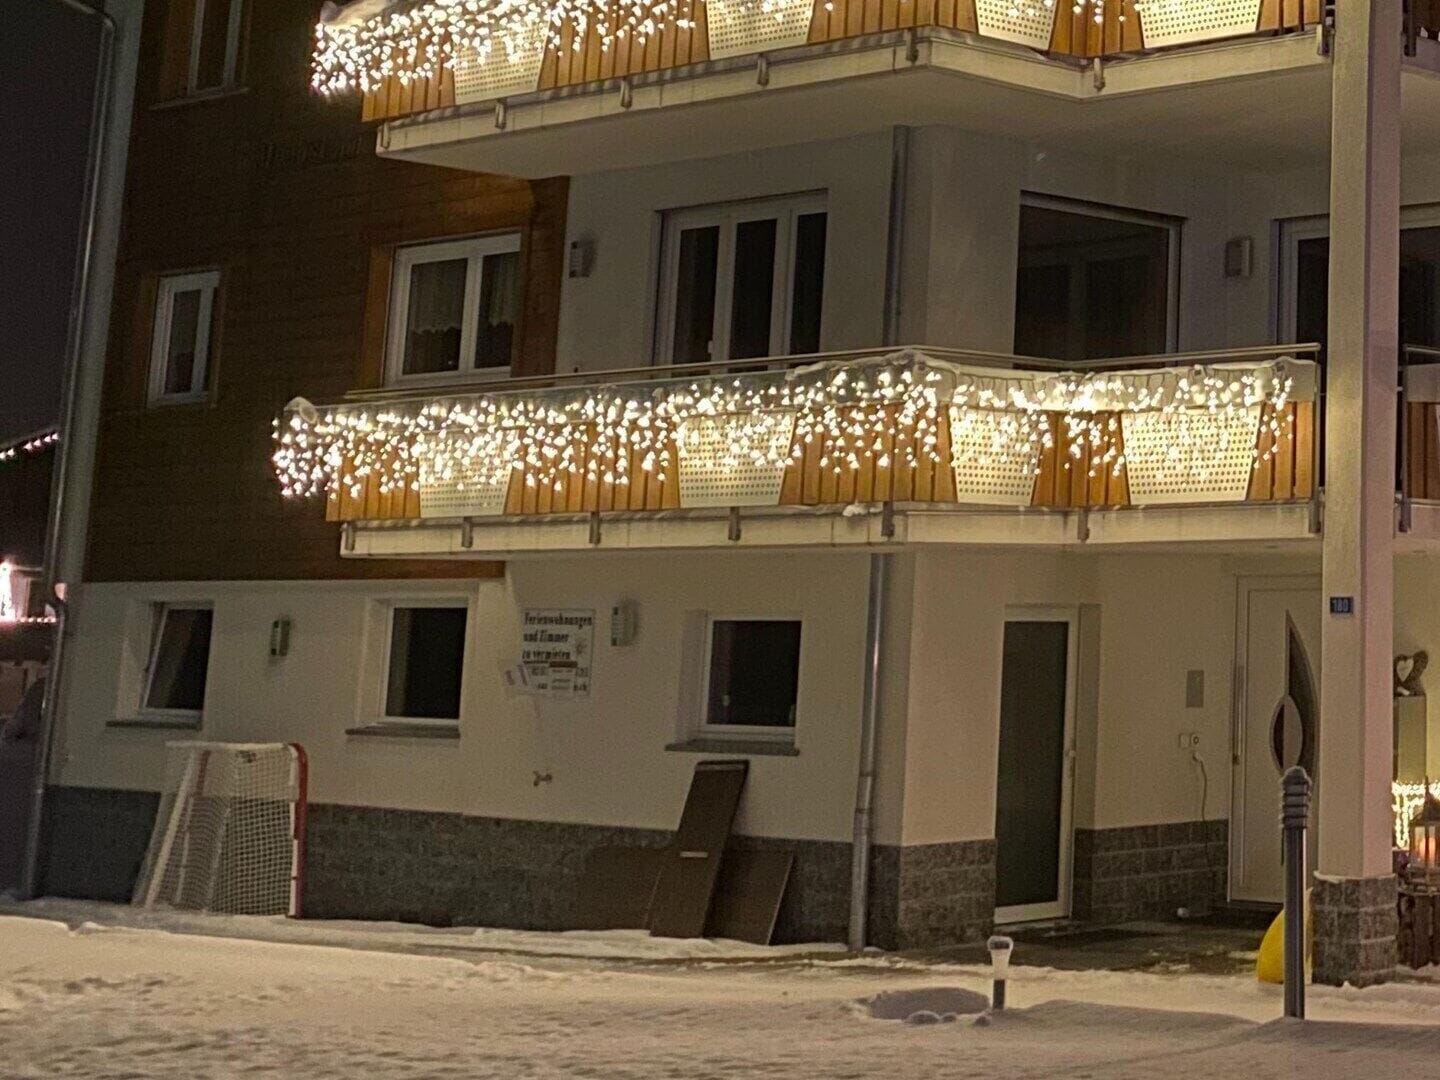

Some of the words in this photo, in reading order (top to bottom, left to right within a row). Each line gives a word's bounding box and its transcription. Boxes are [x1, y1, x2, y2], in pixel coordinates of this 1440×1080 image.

[523, 630, 538, 642] und
[539, 629, 569, 642] Zimmer
[533, 648, 571, 660] vermieten
